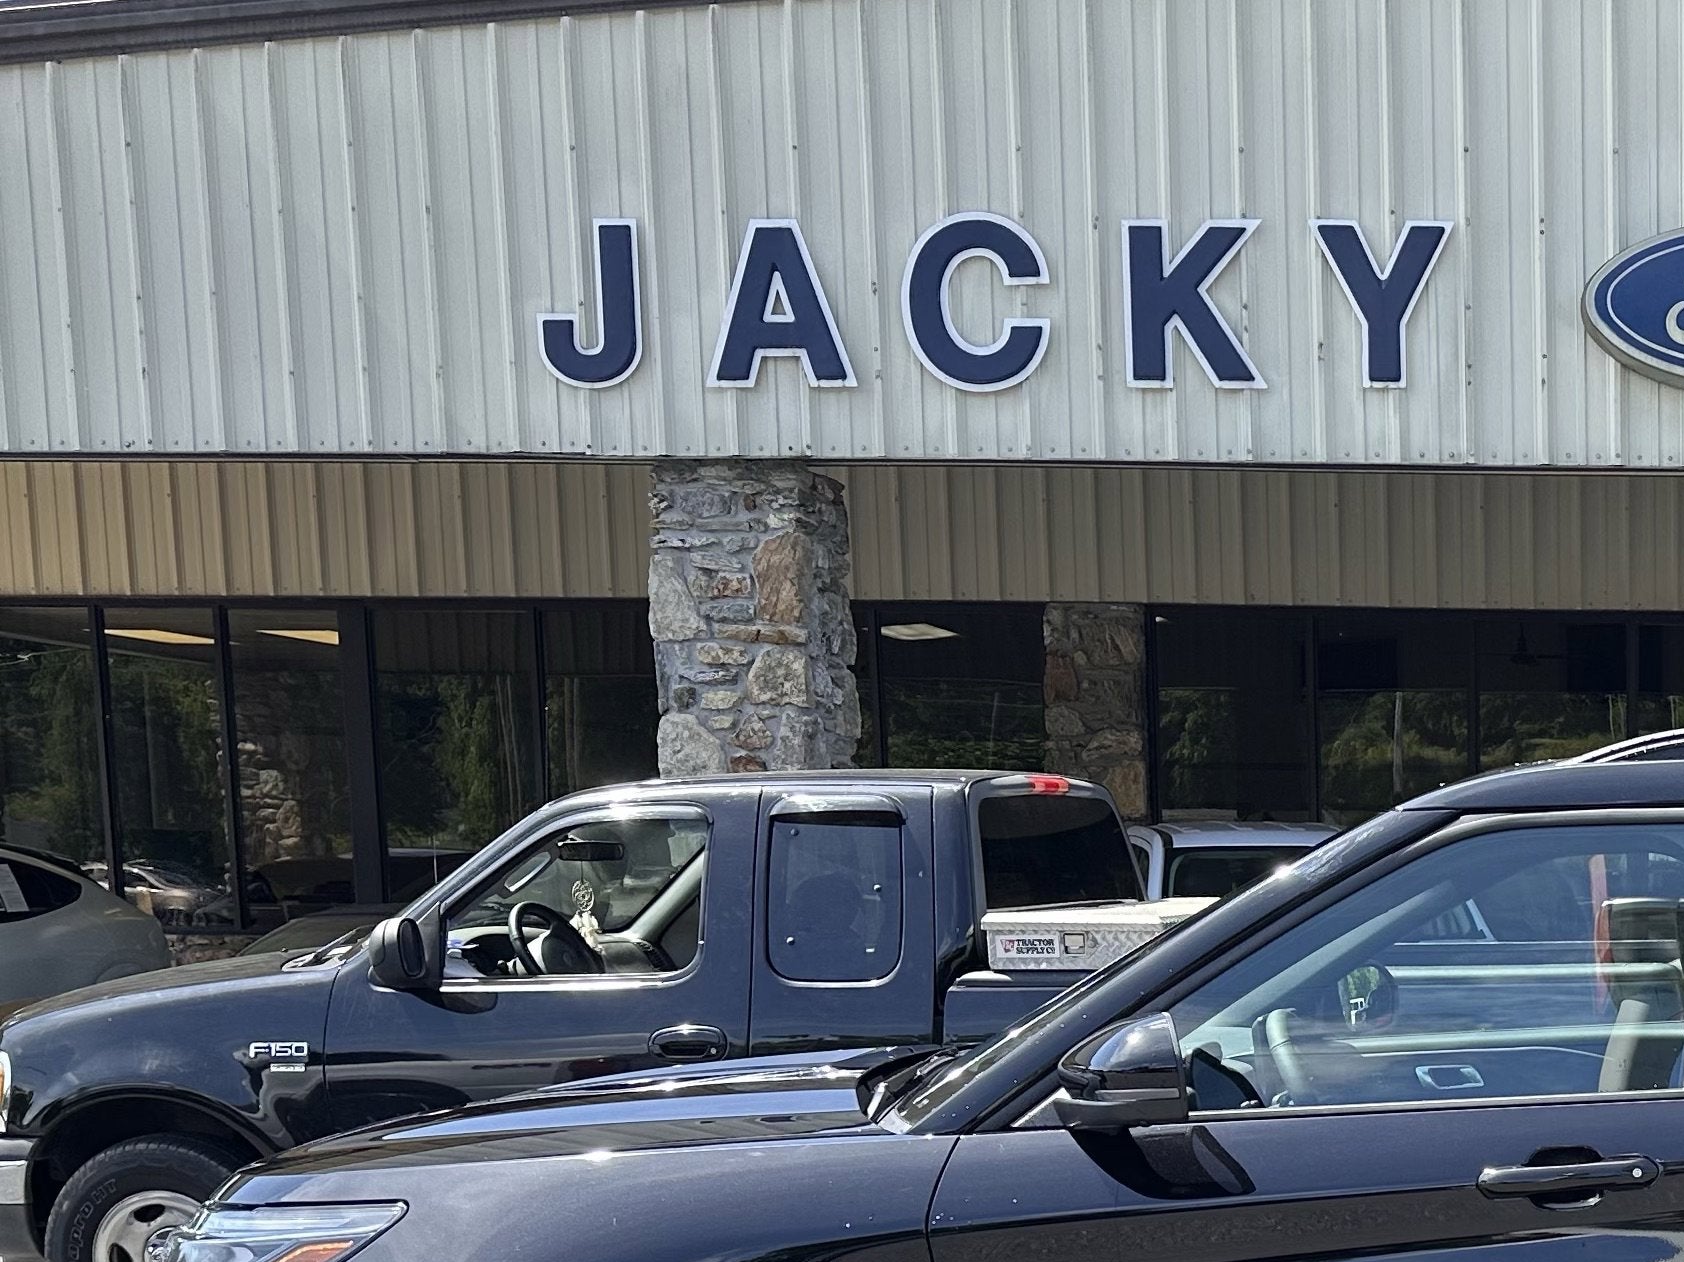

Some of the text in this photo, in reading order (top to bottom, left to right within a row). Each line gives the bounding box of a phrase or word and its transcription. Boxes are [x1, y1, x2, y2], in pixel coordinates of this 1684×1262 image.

[536, 211, 1454, 392] JACKY
[1016, 938, 1055, 947] TRACTOR
[1016, 946, 1045, 955] SUPPLY
